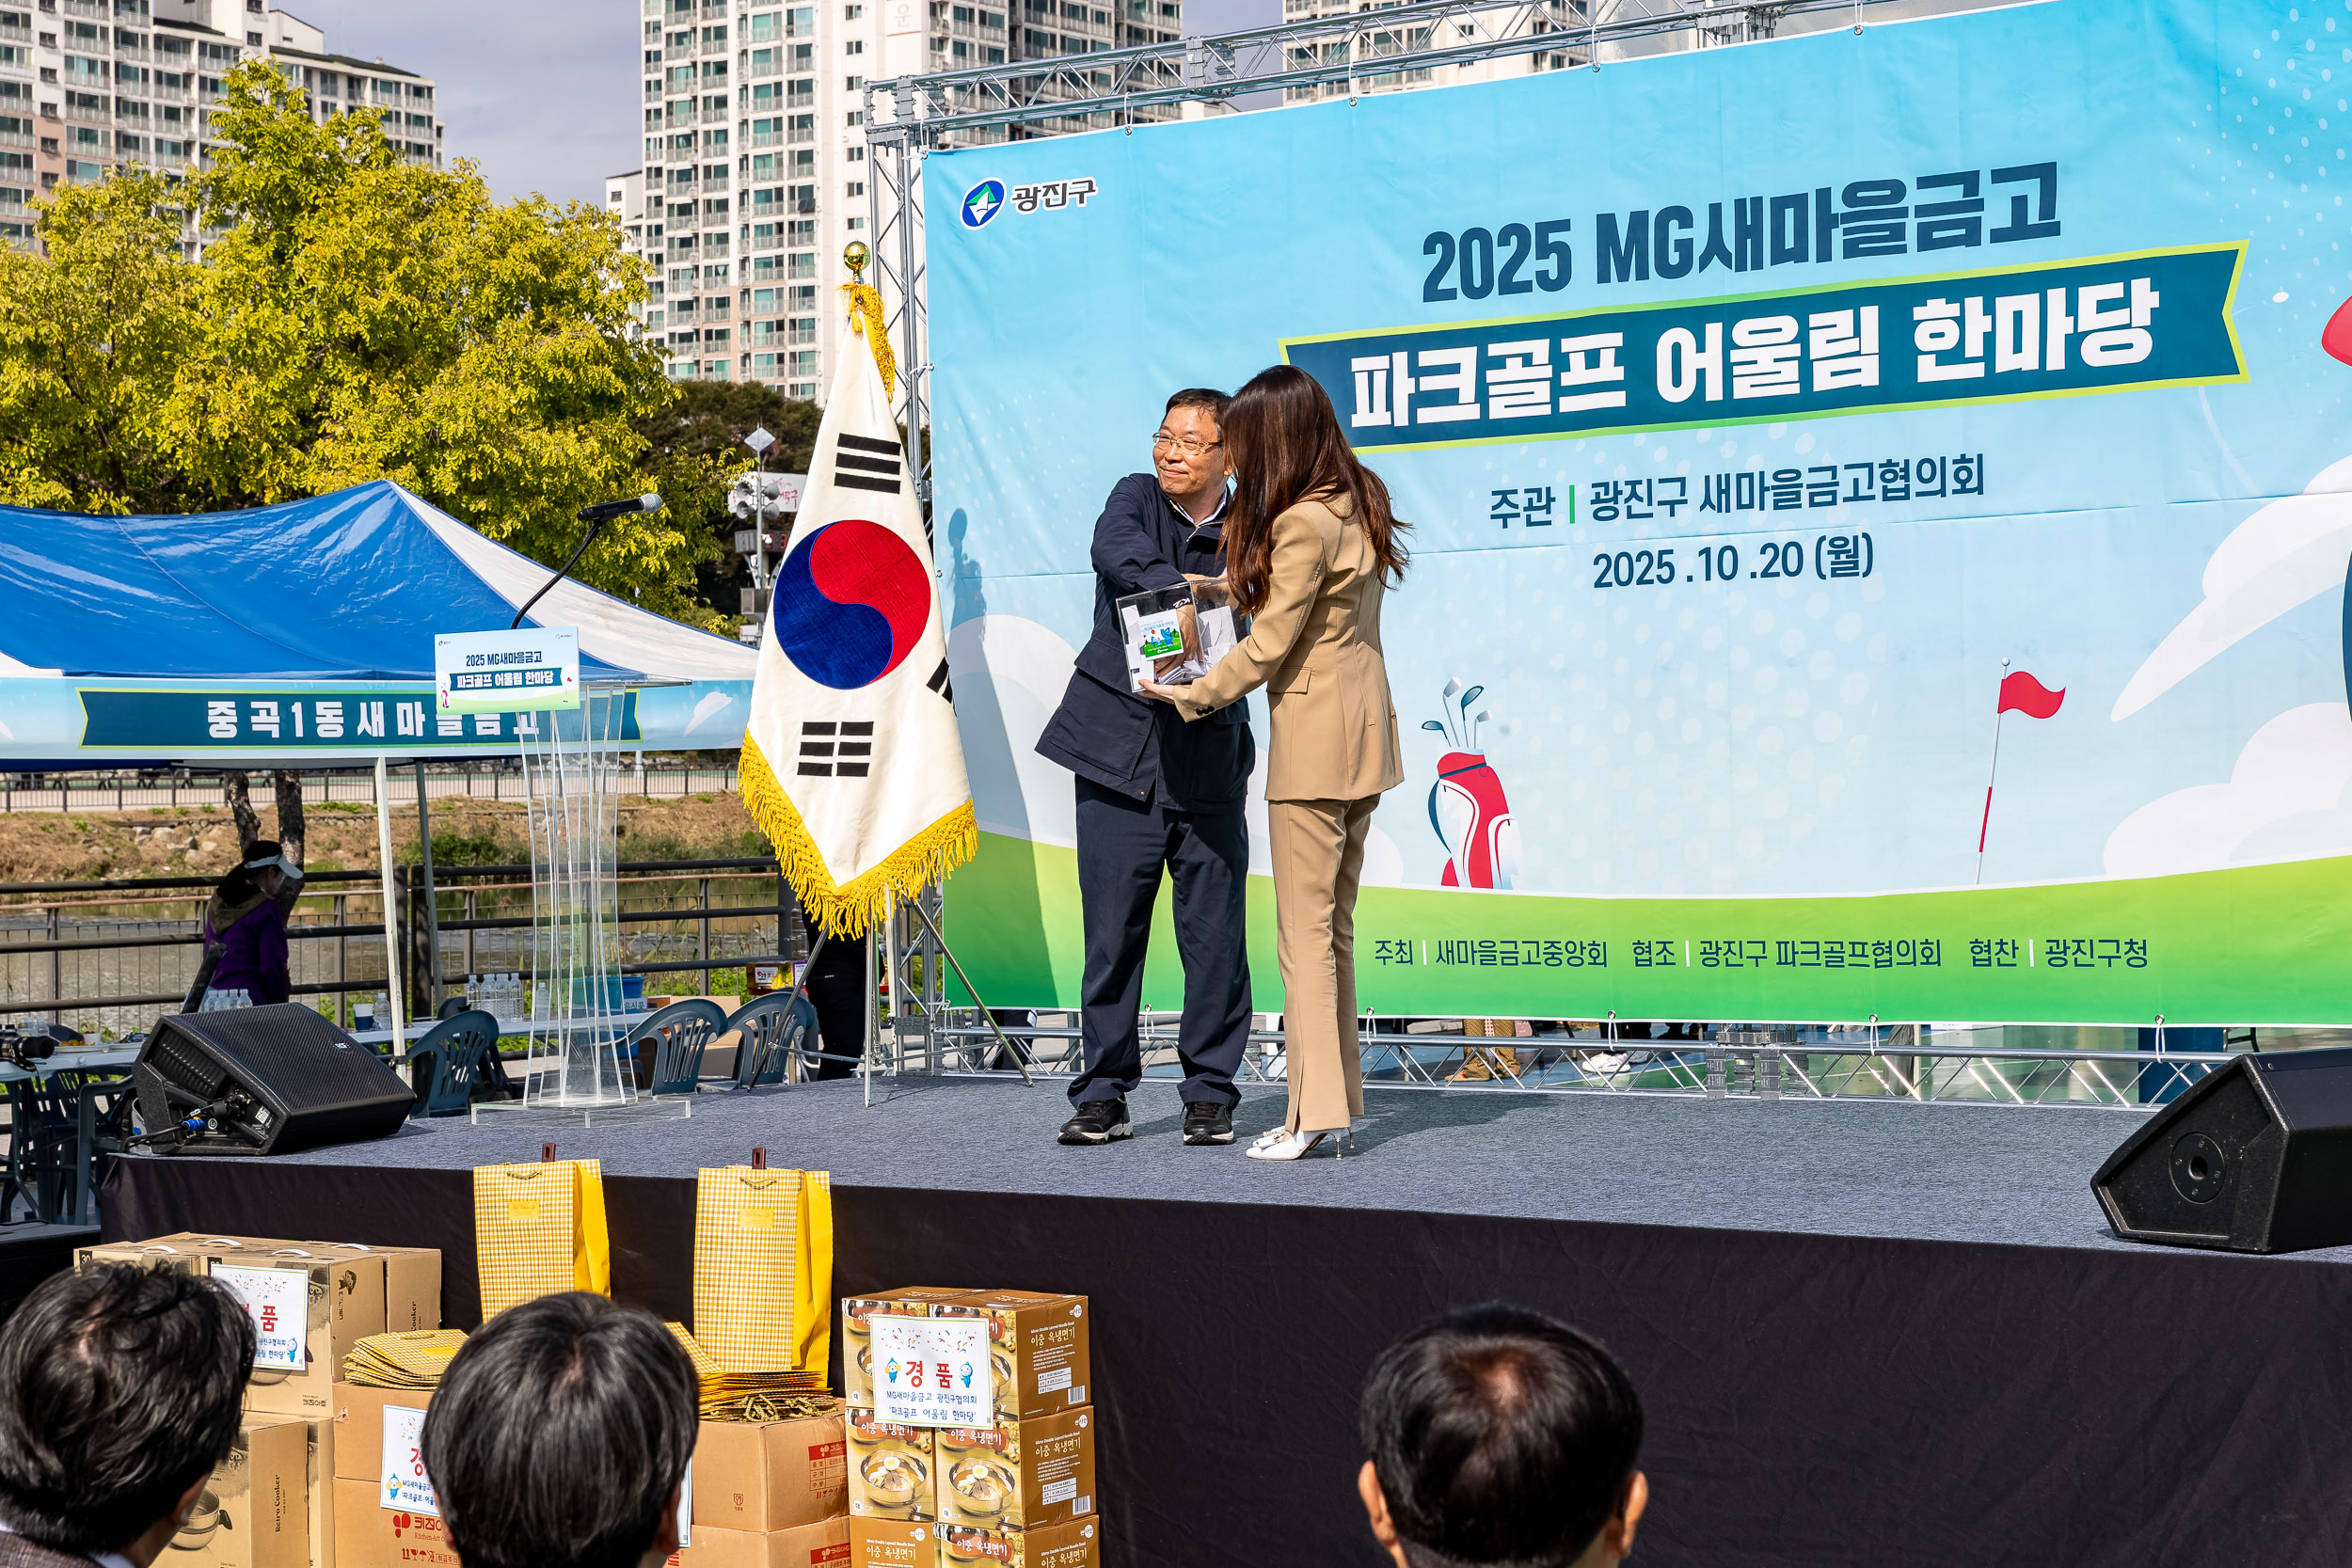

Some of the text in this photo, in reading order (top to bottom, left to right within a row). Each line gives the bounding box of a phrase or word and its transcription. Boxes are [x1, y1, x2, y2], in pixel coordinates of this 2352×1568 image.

[1011, 179, 1096, 213] 광진구
[1422, 161, 2061, 303] 2025 MG새마을금고
[1351, 277, 2160, 428] 파크골프 어울림 한마당
[1489, 453, 1985, 529] 주관 광진구 새마을금고협의회
[1815, 531, 1874, 579] (월)
[466, 651, 542, 667] 2025 MG새마을금고
[456, 670, 554, 689] 파크골프 어울림 한마당
[1375, 938, 2148, 969] 주최 새마을금고중앙회 협조 광진구 파크골프협의회 협찬 광진구청
[1031, 1326, 1075, 1346] 이중 옥냉면기
[886, 1390, 977, 1404] MG새마을금고 광진구협의회
[923, 1408, 947, 1420] 어울림
[862, 1421, 877, 1434] 이중
[950, 1429, 1002, 1446] 이중 옥냉면기
[1035, 1437, 1081, 1457] 이중 옥냉면기
[866, 1545, 881, 1558] 이중
[884, 1546, 916, 1560] 옥냉면기
[957, 1538, 1008, 1557] 이중 옥냉면기
[1041, 1548, 1088, 1568] 이중 옥냉면기
